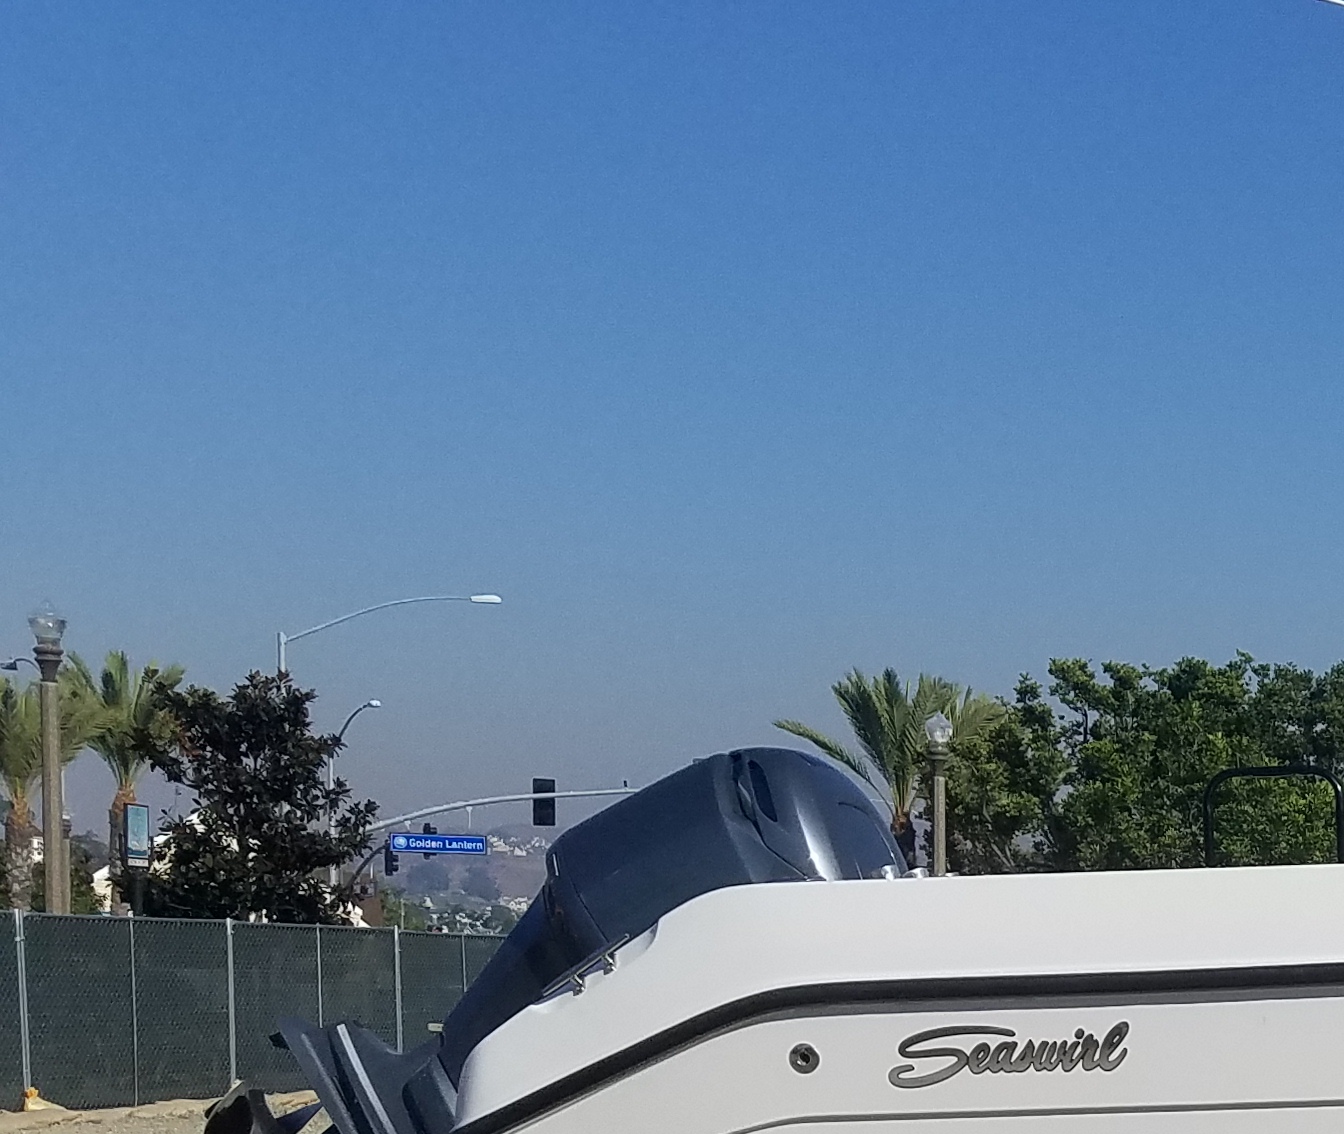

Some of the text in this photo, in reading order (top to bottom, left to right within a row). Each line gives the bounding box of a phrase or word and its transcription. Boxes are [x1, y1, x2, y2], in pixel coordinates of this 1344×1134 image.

[409, 838, 483, 850] Golden Lantern
[888, 1021, 1129, 1088] Seaswirl
